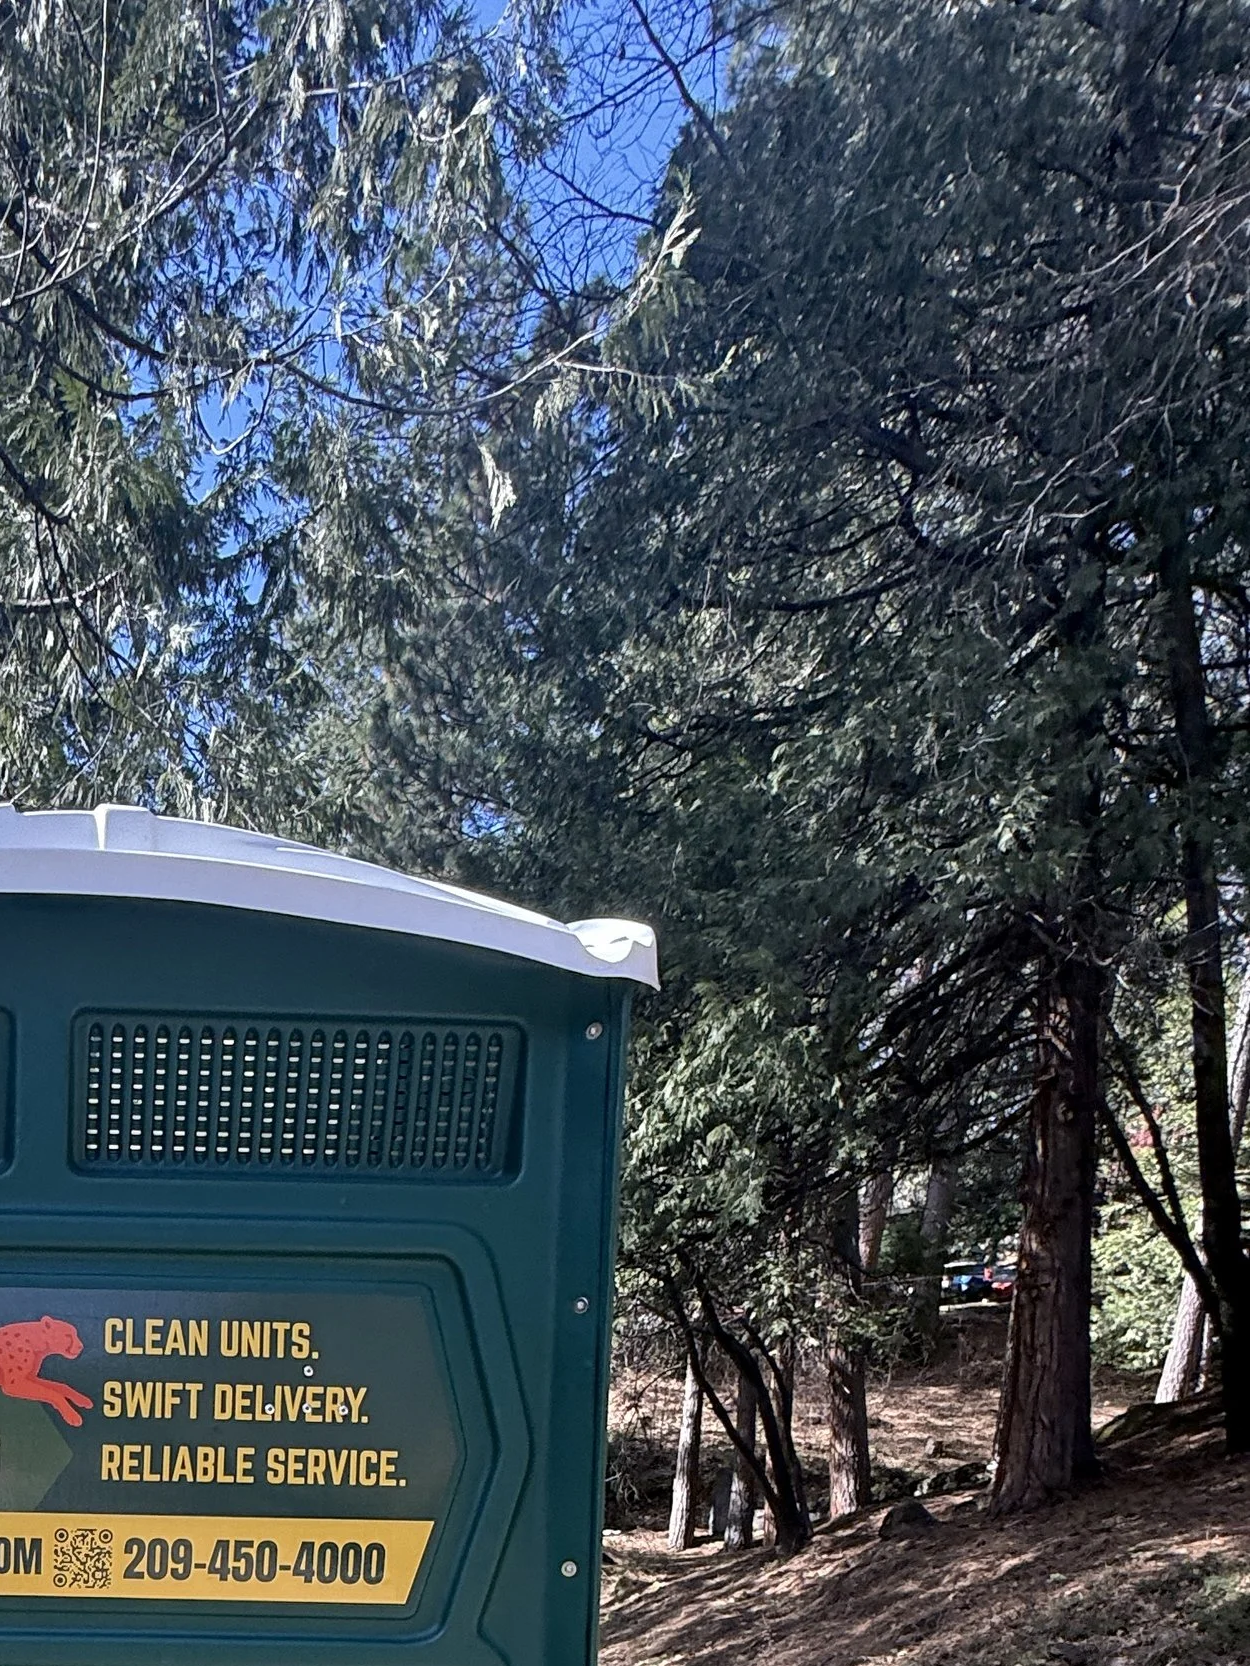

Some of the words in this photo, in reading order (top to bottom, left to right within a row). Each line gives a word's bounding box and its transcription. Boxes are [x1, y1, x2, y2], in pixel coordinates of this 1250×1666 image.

[104, 1318, 209, 1356] CLEAN
[220, 1320, 320, 1360] UNITS.
[103, 1381, 203, 1420] SWIFT
[214, 1383, 369, 1423] DELIVERY.
[101, 1444, 255, 1484] RELIABLE
[266, 1447, 407, 1487] SERVICE.
[123, 1537, 387, 1585] 209-450-4000
